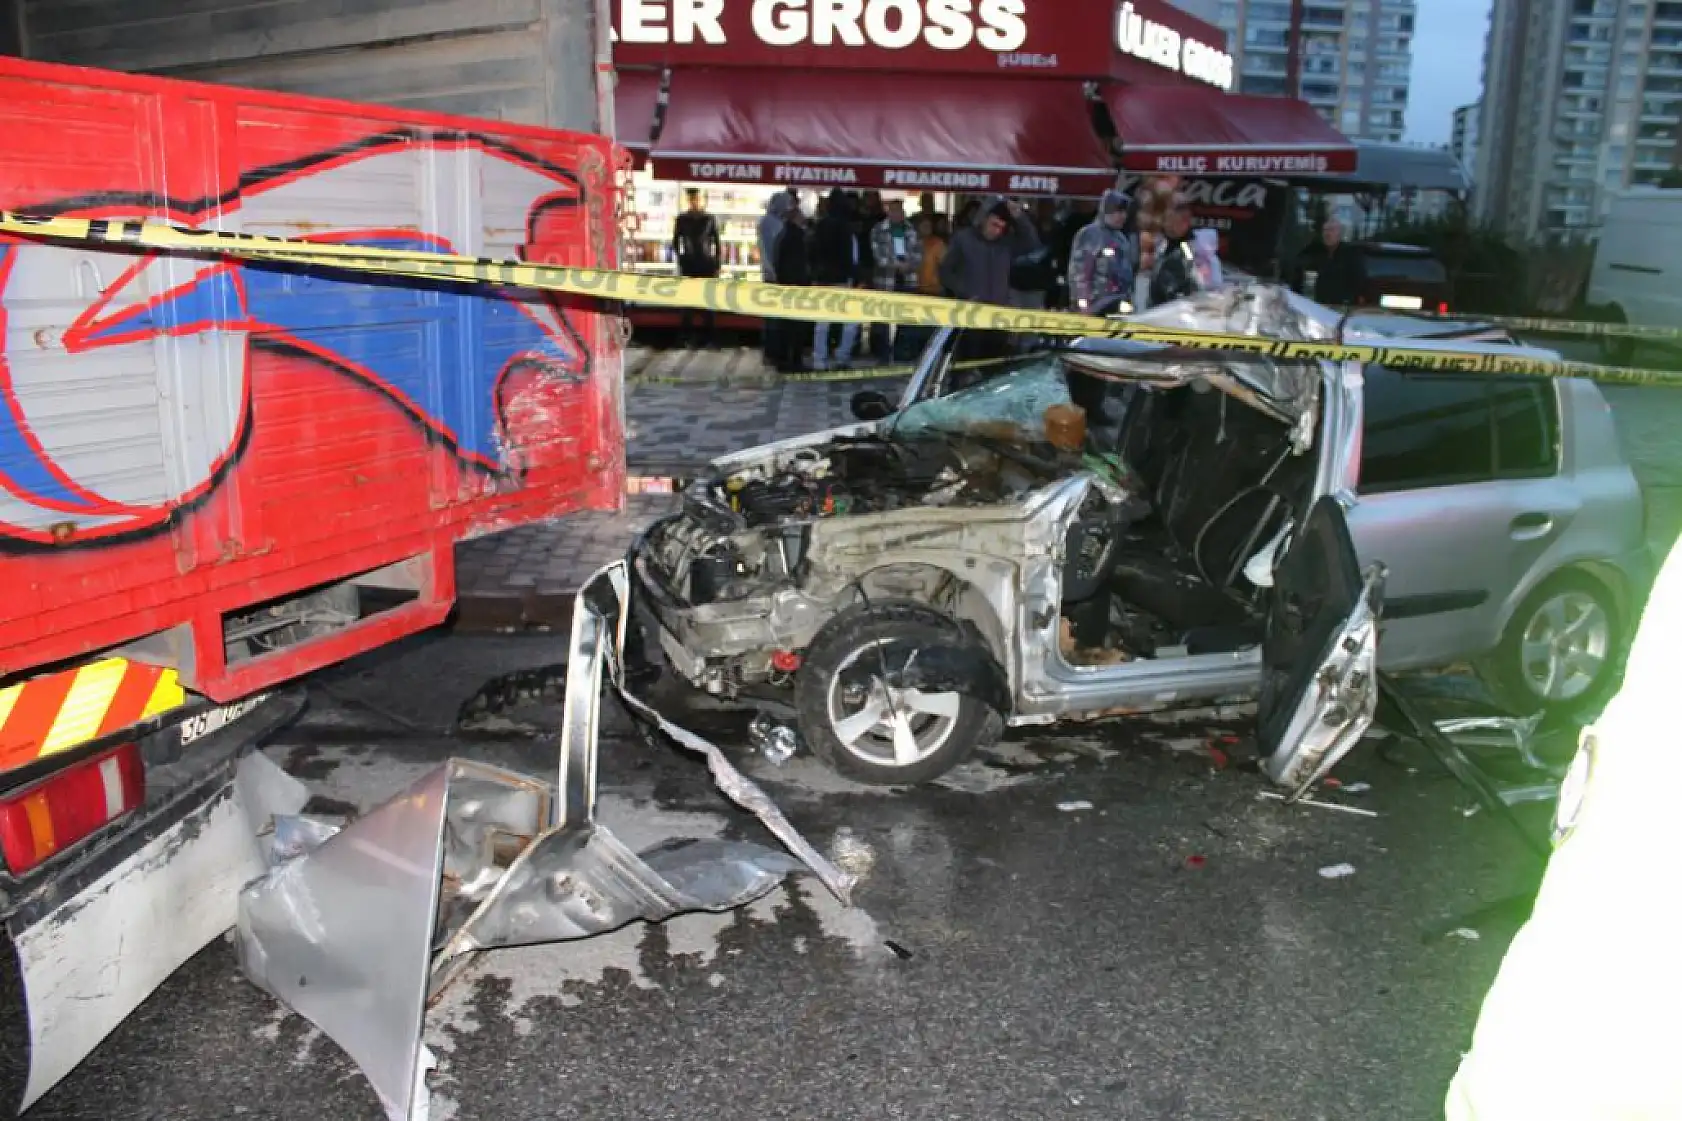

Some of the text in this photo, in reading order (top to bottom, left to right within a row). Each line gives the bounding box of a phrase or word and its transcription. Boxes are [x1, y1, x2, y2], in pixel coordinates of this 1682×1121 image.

[610, 0, 1027, 51] ER GROSS
[690, 162, 1059, 194] TOPTAN FİYATINA PERAKENDE SATIŞ
[1157, 153, 1327, 173] KILIÇ KURUYEMİŞ
